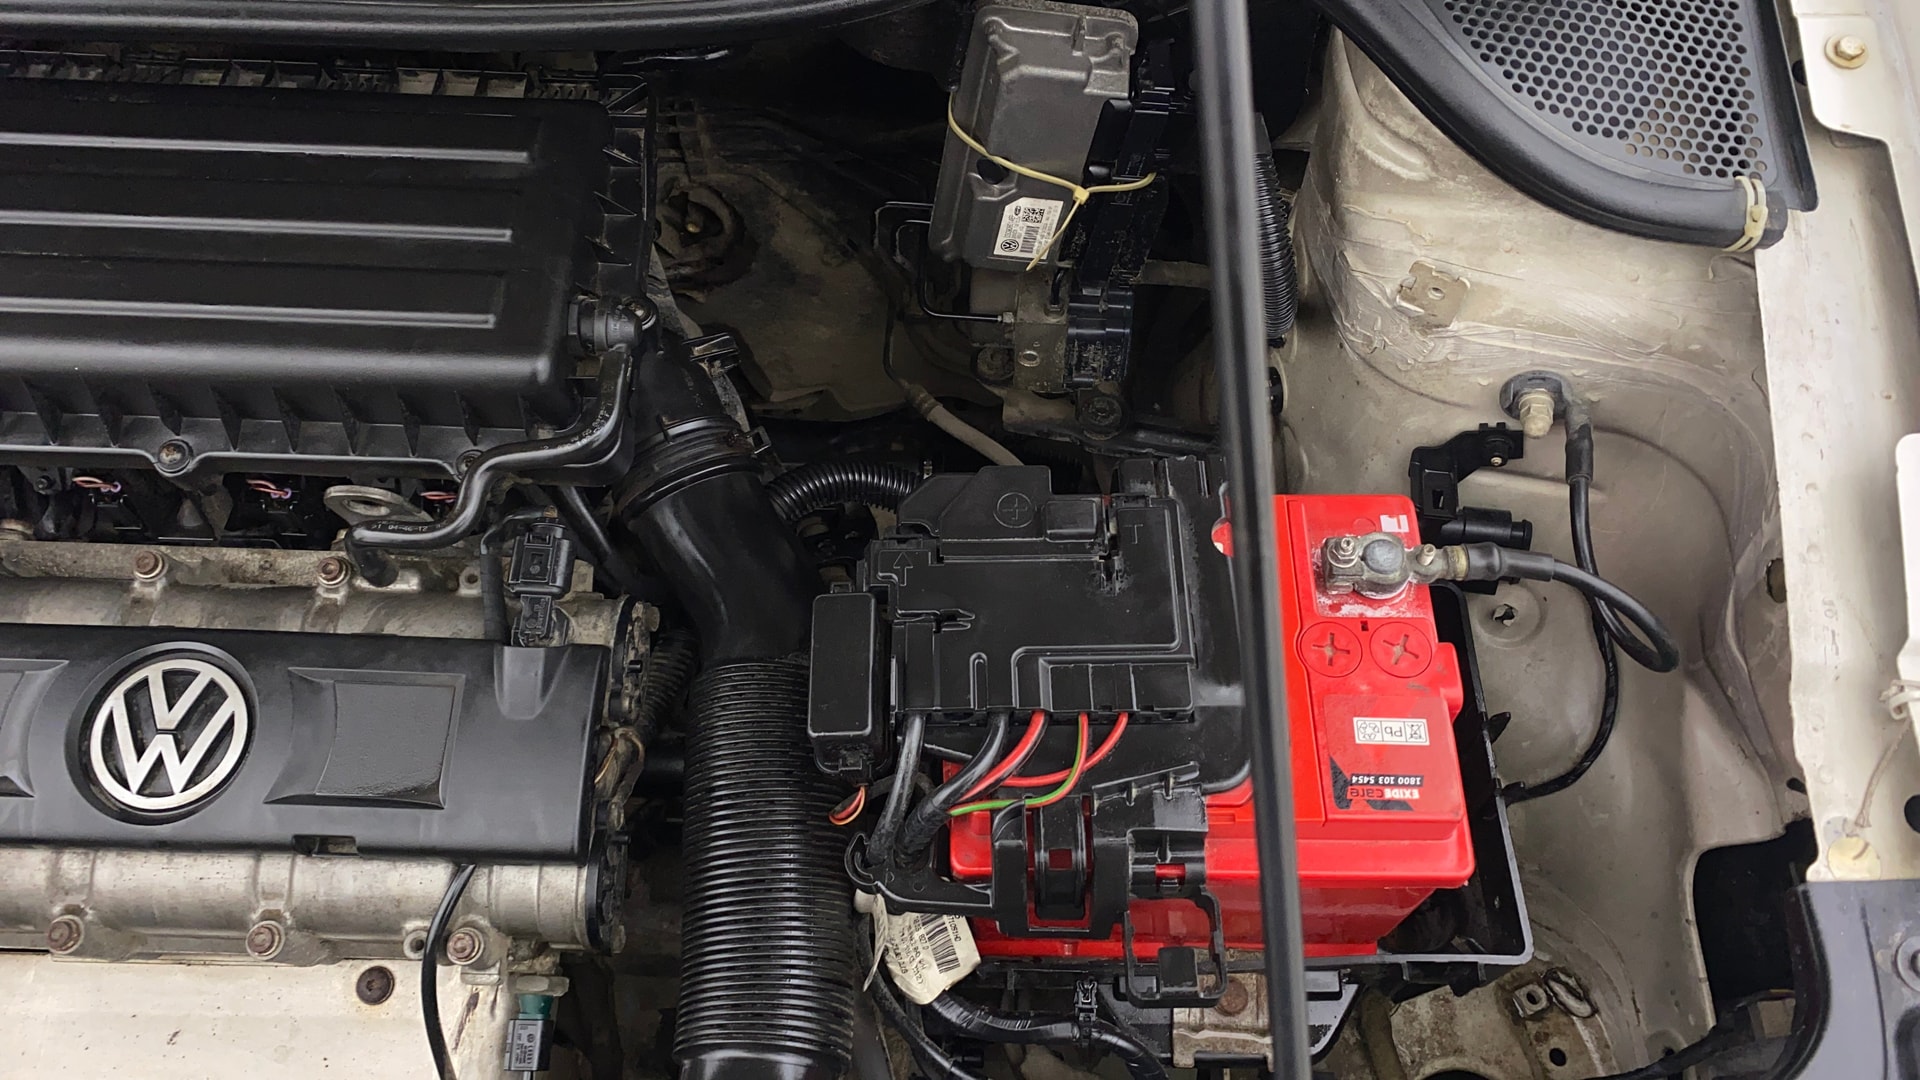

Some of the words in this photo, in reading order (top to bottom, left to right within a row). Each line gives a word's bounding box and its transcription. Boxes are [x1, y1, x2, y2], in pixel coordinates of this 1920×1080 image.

[1384, 726, 1403, 738] Pb
[1352, 776, 1375, 784] 5454
[1378, 777, 1394, 785] 103
[1398, 777, 1421, 785] 1800
